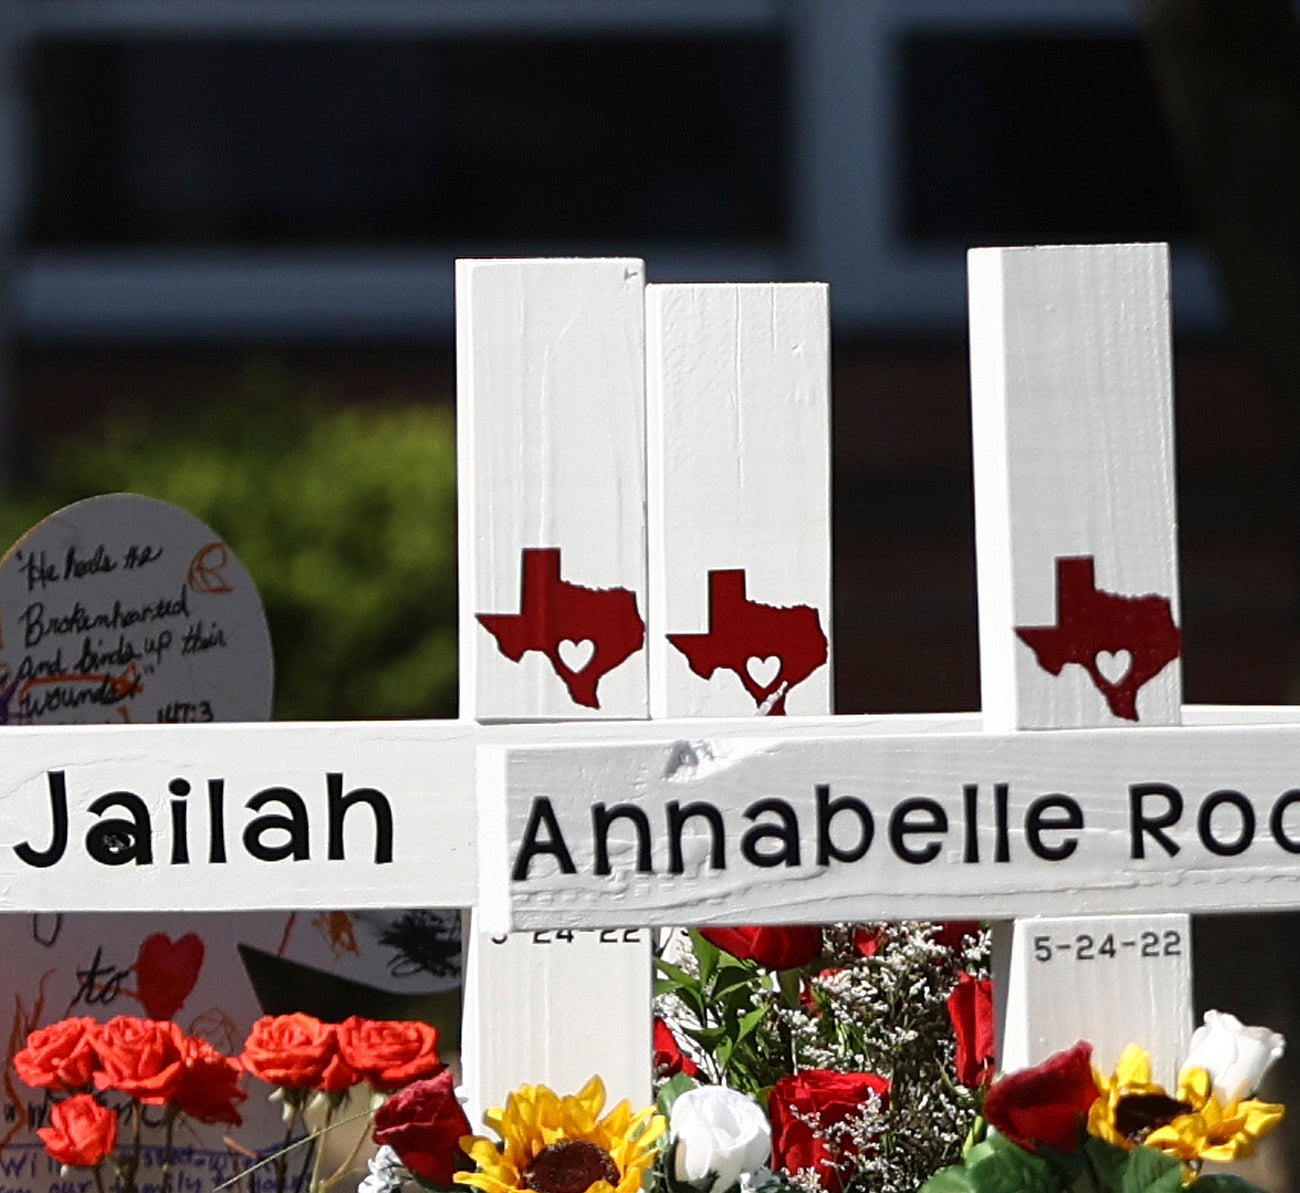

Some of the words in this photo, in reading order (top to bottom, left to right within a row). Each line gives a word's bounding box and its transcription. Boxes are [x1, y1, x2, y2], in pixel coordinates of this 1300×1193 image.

[13, 770, 393, 868] Jailah
[511, 783, 1085, 881] Annabelle
[68, 946, 130, 1010] to
[1034, 930, 1181, 962] 5-24-22
